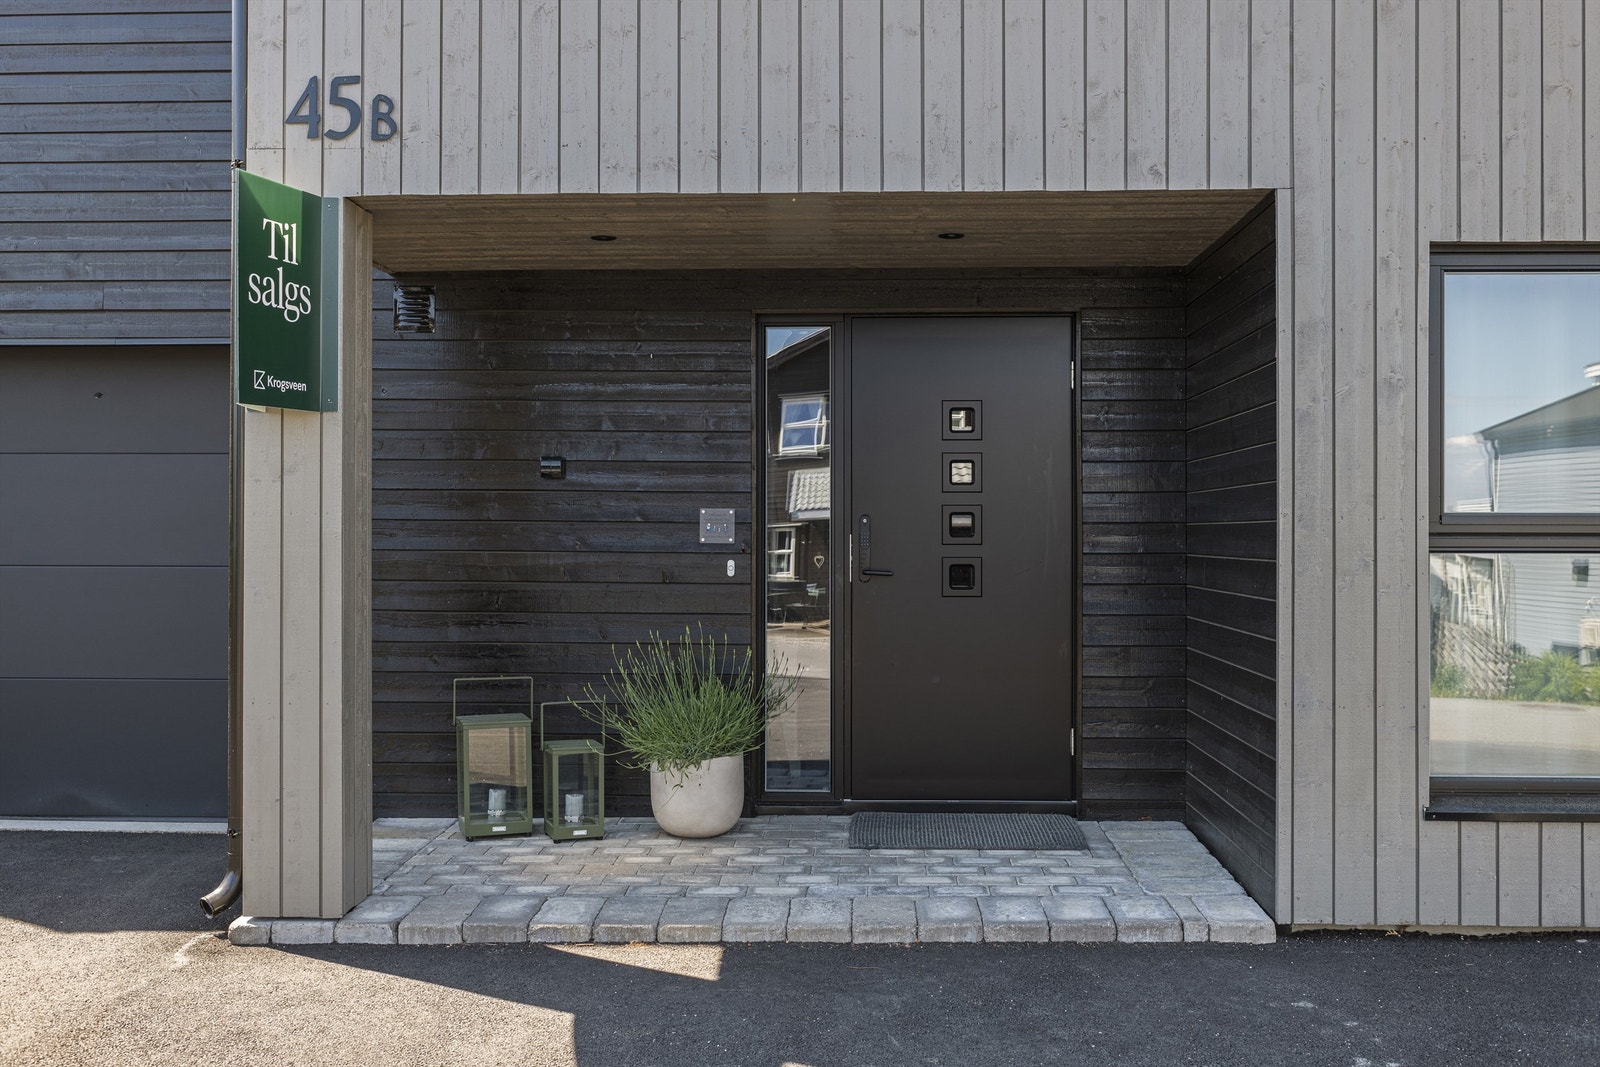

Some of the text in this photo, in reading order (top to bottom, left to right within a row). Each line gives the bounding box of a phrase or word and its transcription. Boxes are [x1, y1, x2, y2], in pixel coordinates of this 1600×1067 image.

[262, 217, 299, 266] Til
[247, 266, 312, 323] salgs
[267, 375, 307, 393] Krogsveen
